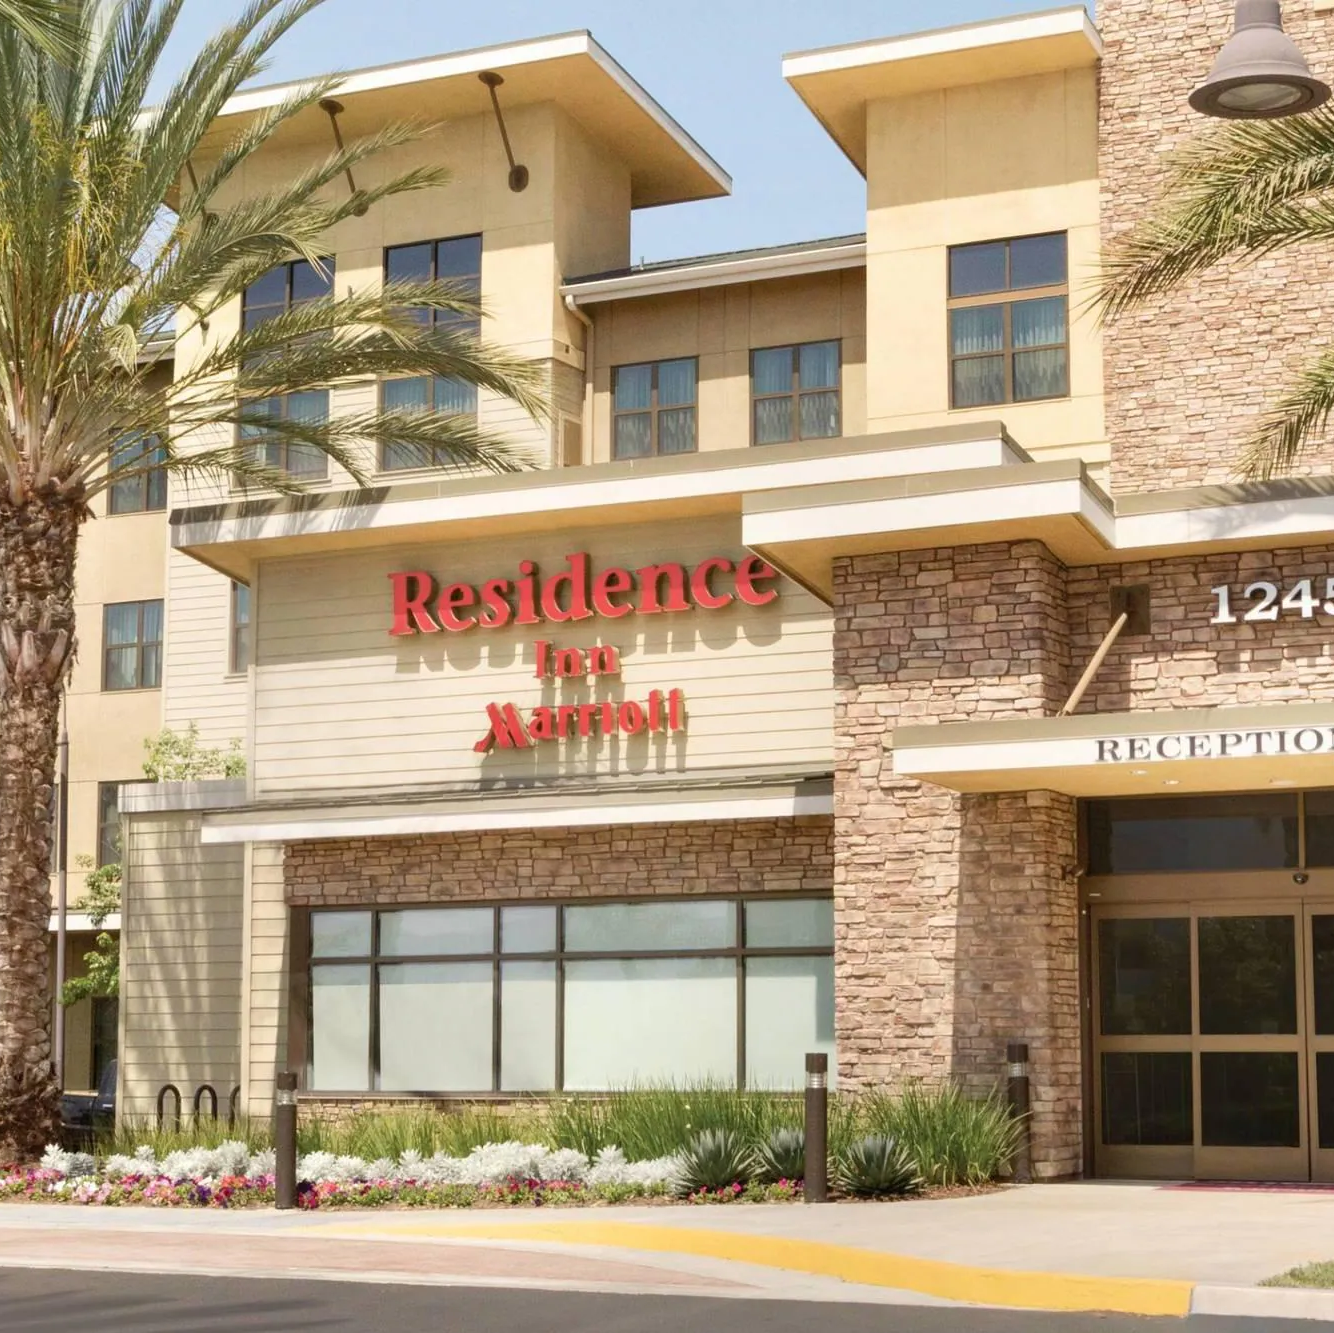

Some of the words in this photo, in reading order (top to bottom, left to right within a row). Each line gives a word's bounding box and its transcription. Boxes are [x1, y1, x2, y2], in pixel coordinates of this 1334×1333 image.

[387, 551, 779, 636] Residence
[533, 640, 620, 679] Inn
[473, 688, 685, 753] Marriott
